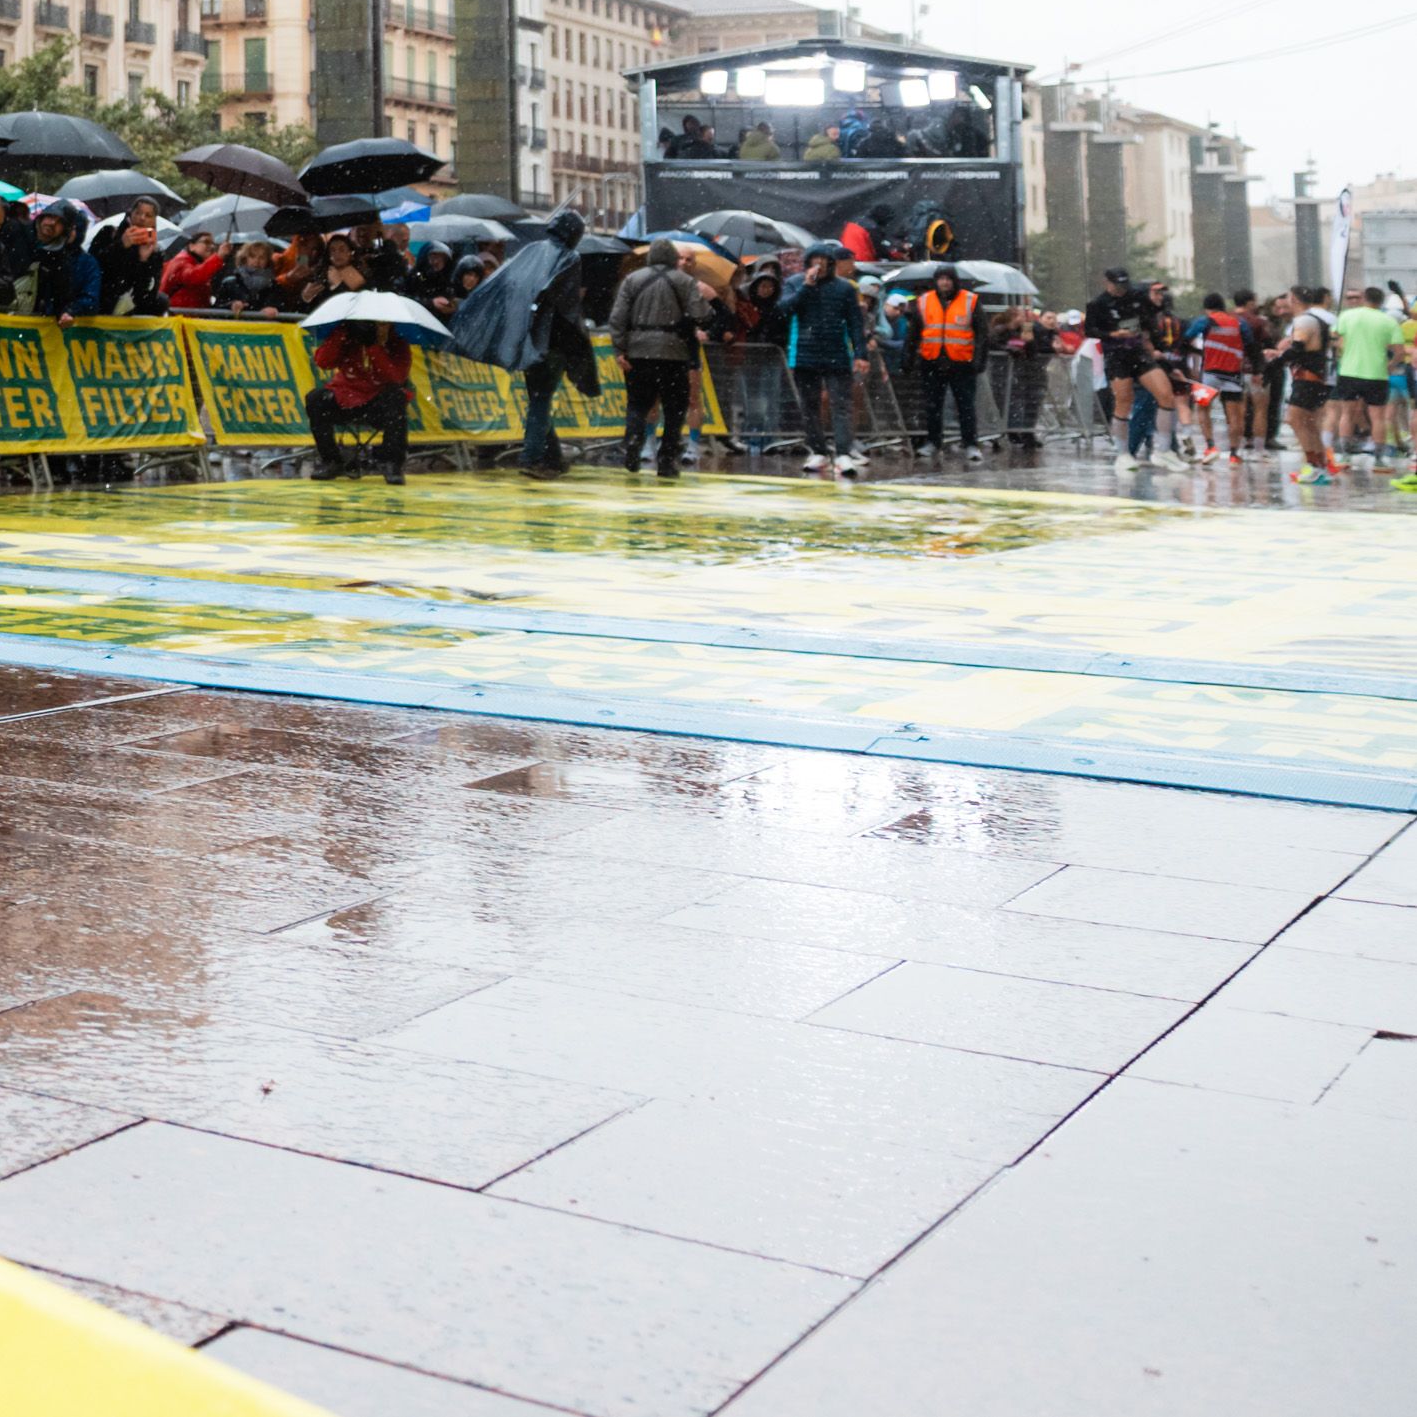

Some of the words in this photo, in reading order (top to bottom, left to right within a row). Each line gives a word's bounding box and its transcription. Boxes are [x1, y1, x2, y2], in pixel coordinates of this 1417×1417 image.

[71, 336, 180, 381] MANN
[203, 343, 290, 382] MANN
[80, 384, 188, 426] FILTER
[214, 387, 303, 424] FILTER
